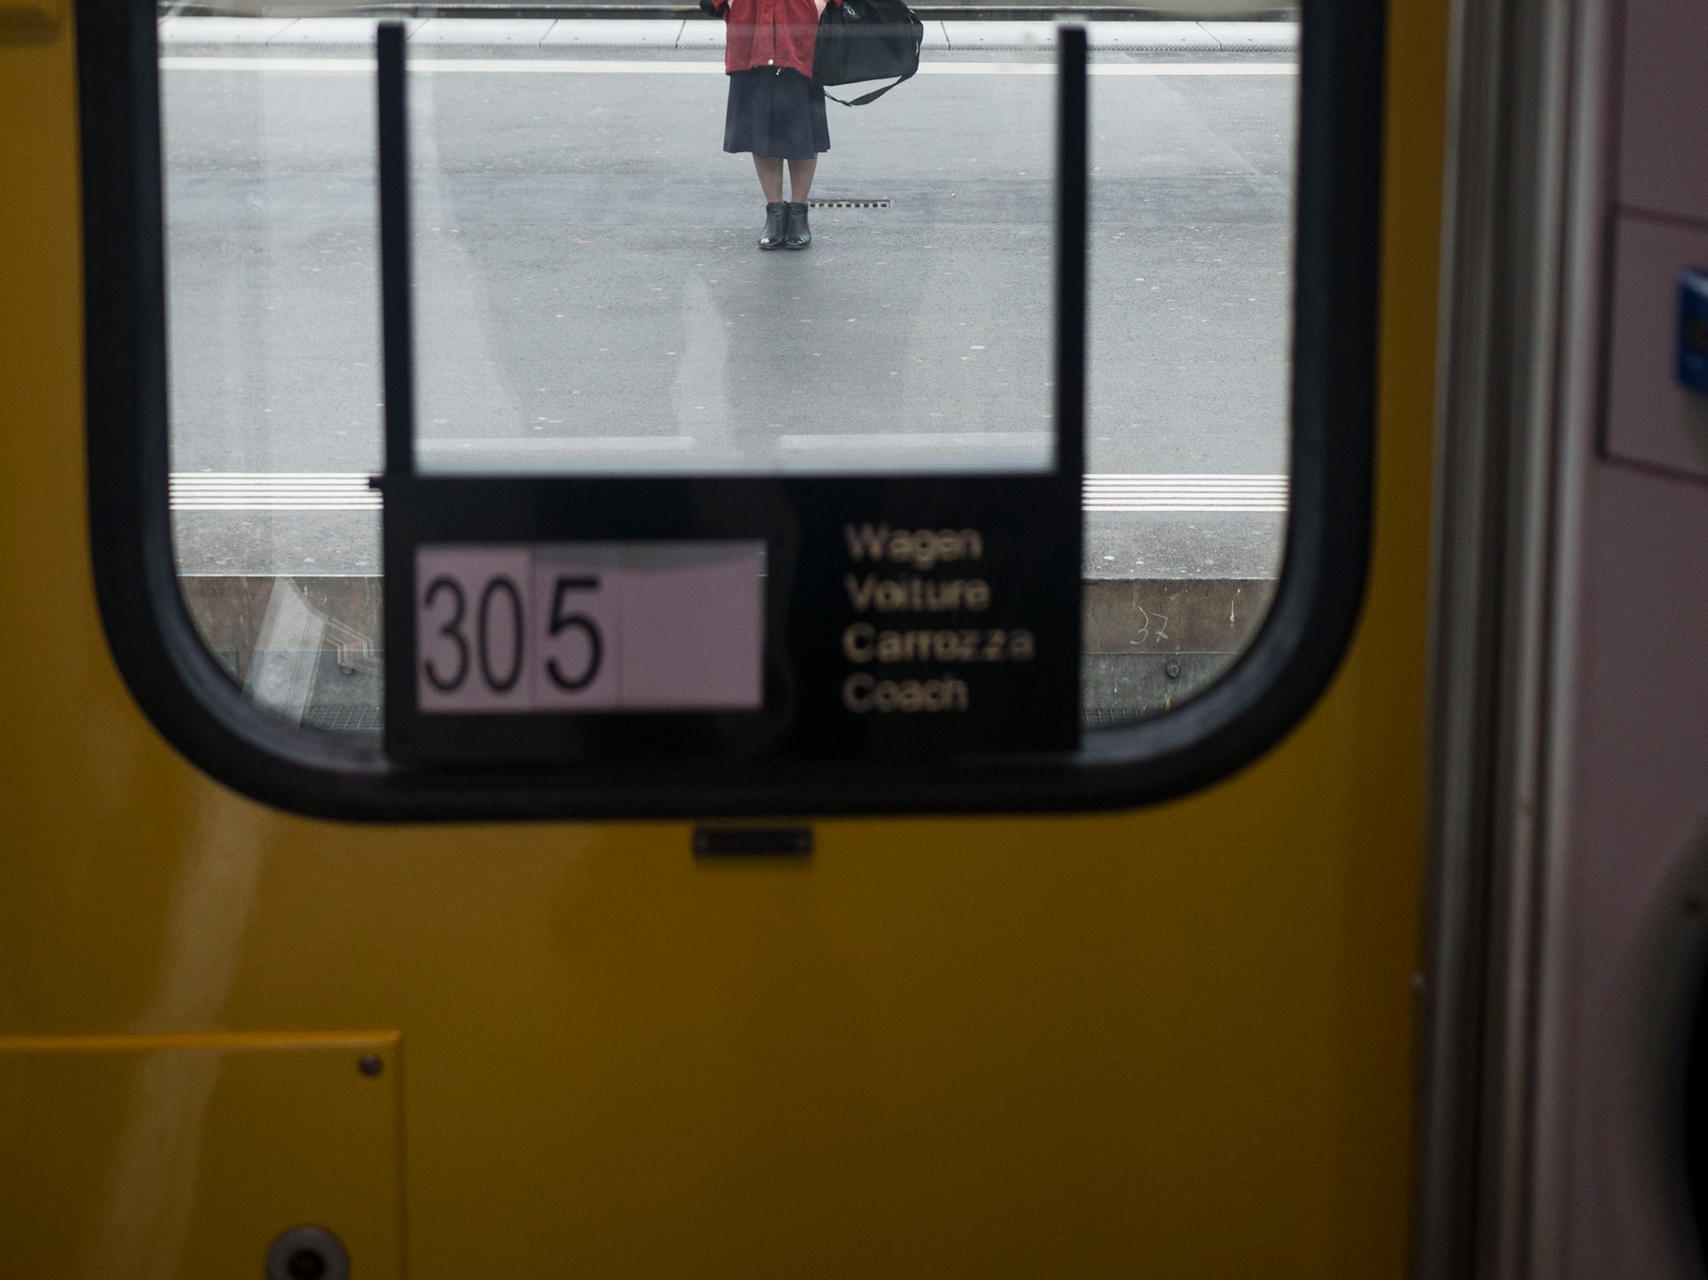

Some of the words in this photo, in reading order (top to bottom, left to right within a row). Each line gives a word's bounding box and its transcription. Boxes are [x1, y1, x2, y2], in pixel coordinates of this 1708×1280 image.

[844, 523, 983, 569] Wagen
[844, 573, 991, 612] Voiture
[424, 574, 604, 692] 305
[842, 622, 1035, 663] Carrozza
[842, 672, 970, 713] Coach
